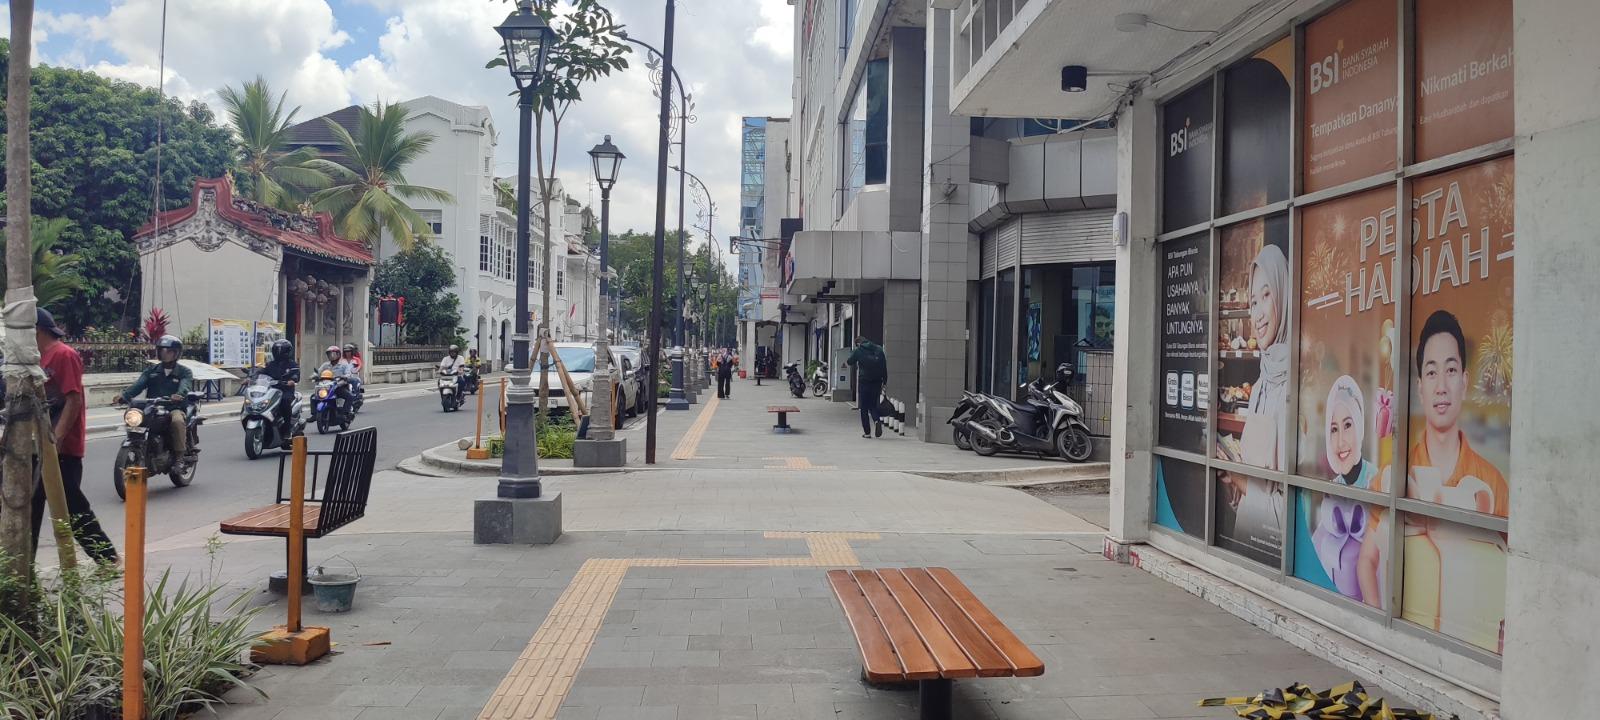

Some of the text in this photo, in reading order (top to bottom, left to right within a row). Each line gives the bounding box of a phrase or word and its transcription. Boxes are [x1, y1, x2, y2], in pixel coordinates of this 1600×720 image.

[1342, 37, 1389, 68] BANK SYARIAH
[1310, 51, 1339, 95] BSI
[1342, 56, 1378, 80] INDONESIA
[1420, 64, 1467, 97] Nikmati
[1310, 110, 1357, 138] Tempatkan
[1170, 127, 1187, 157] BSI
[1167, 262, 1193, 279] APA PUN
[1166, 301, 1190, 316] BANYAK
[1166, 320, 1204, 335] UNTUNGNYA
